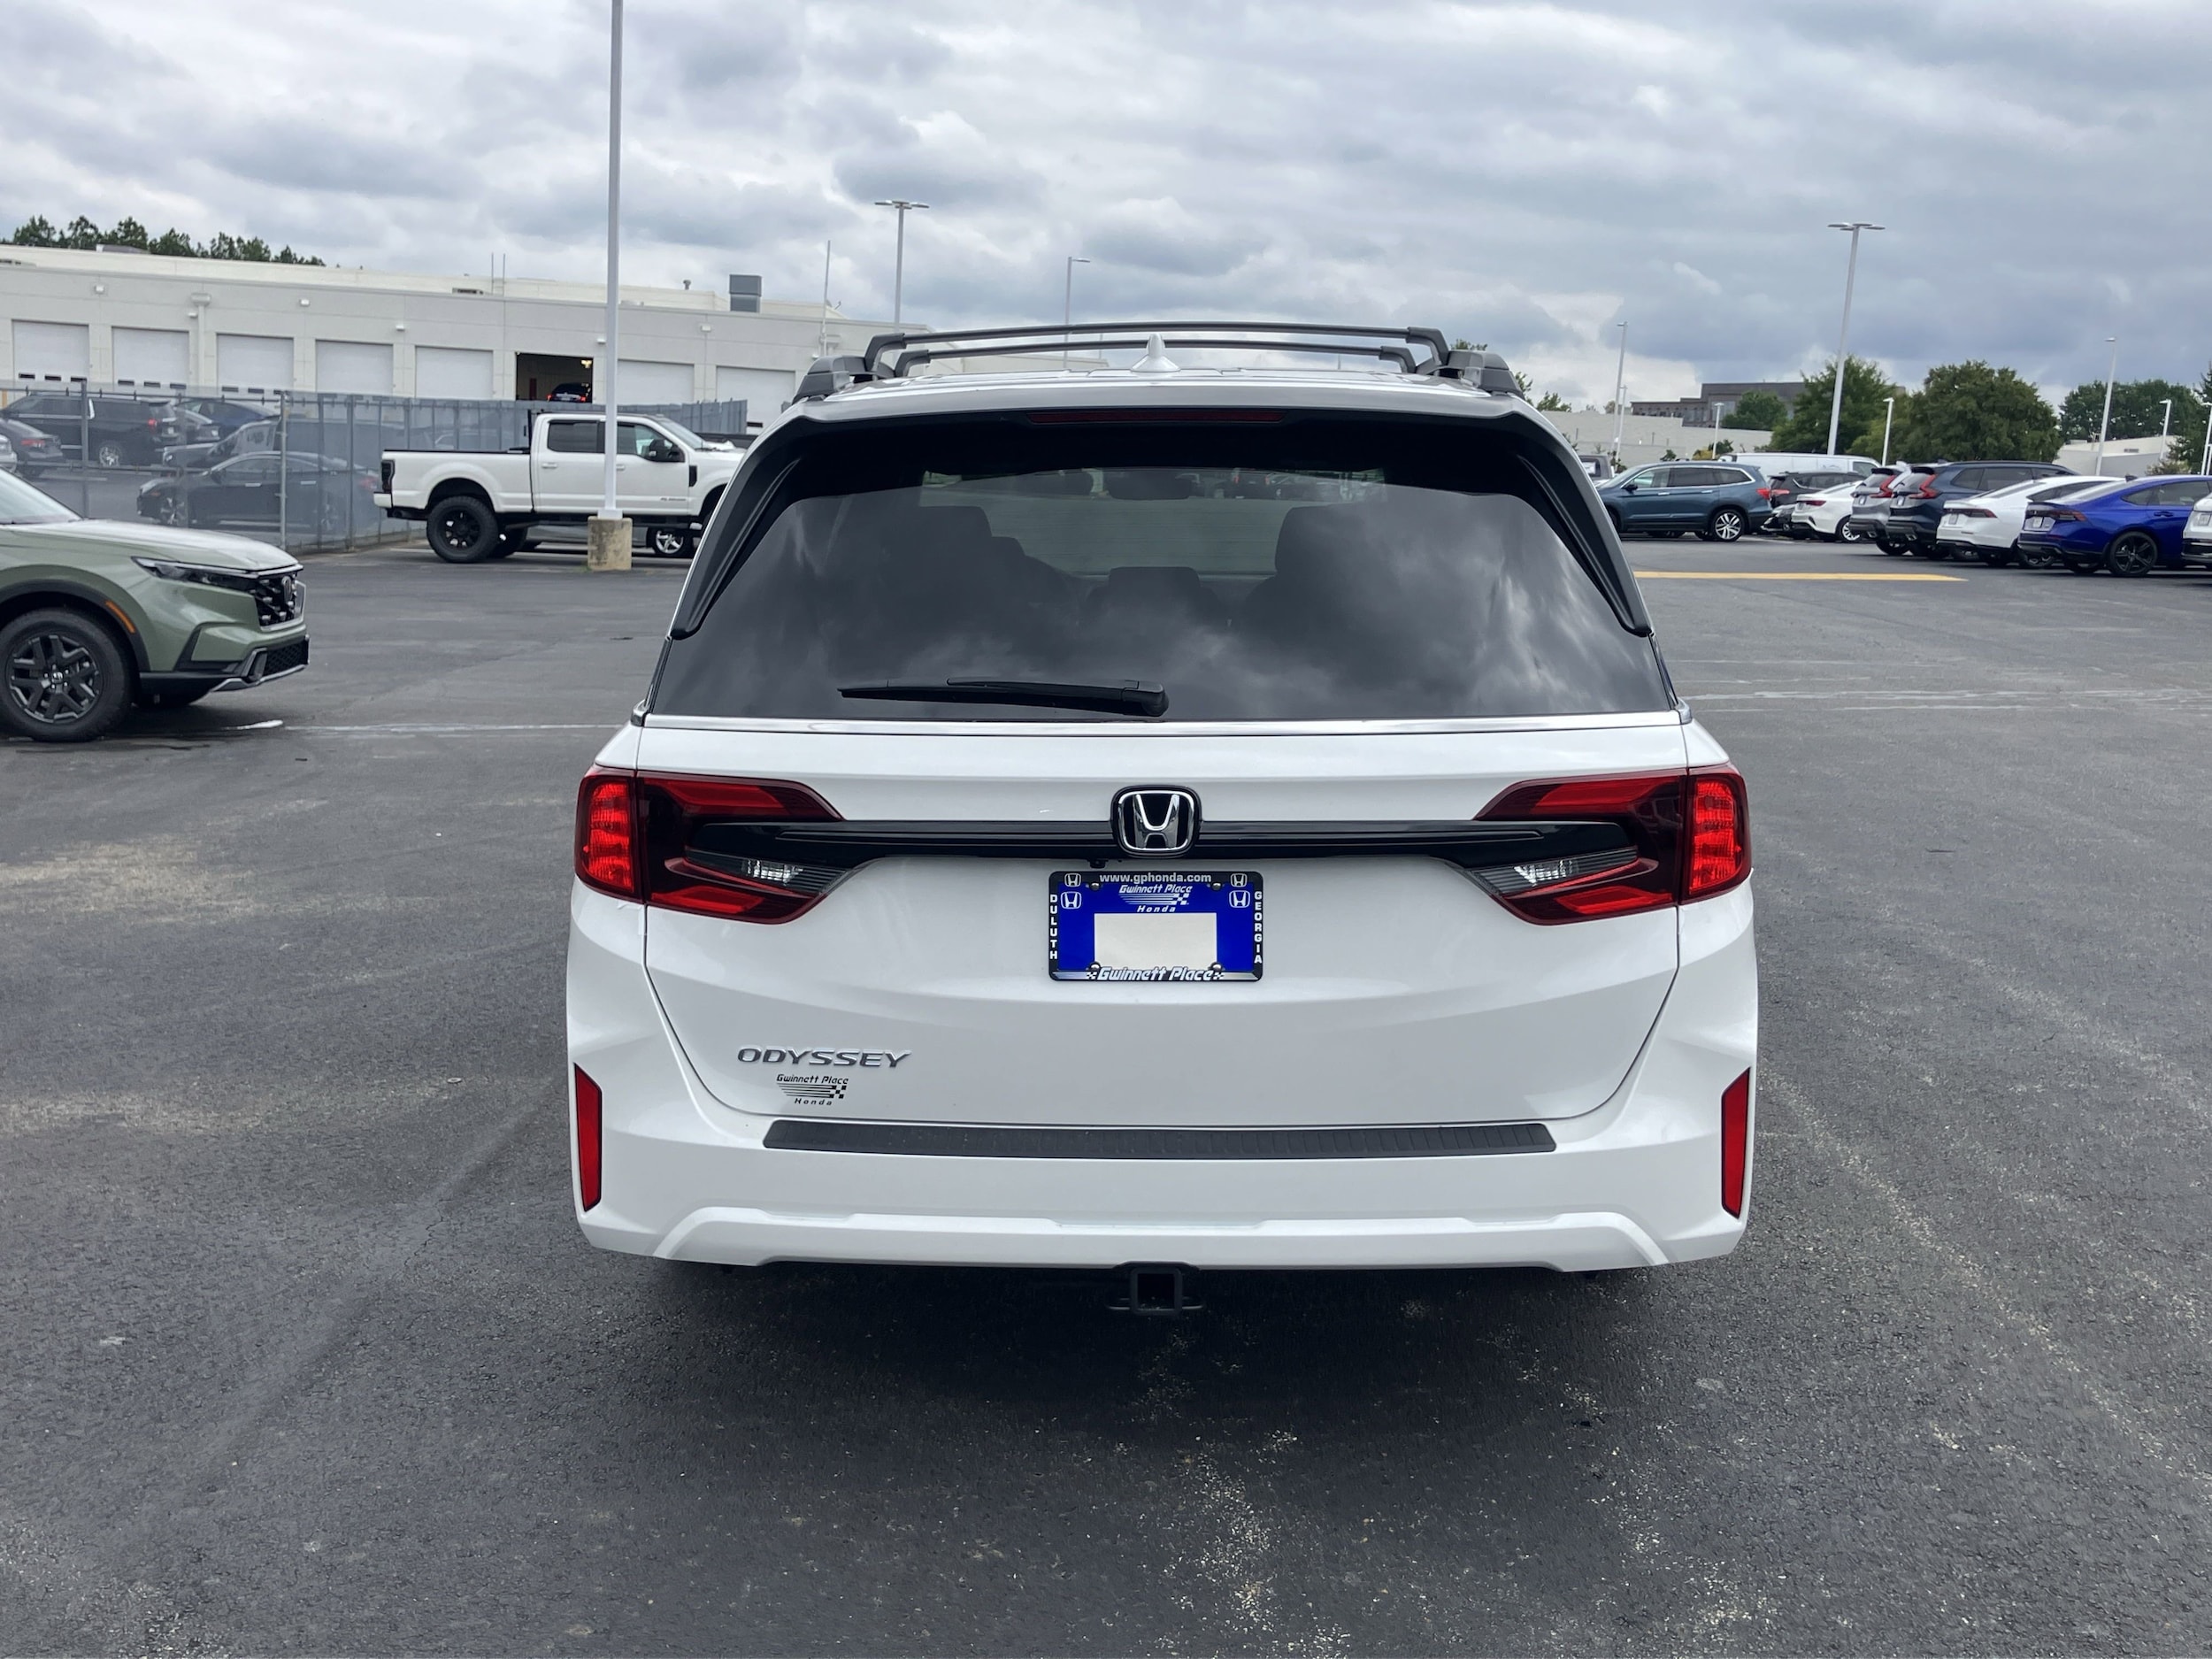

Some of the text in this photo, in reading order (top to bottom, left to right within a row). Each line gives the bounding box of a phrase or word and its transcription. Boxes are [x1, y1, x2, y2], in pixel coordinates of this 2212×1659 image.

[1099, 872, 1211, 884] www.gphonda.com
[1118, 884, 1193, 894] Gwinnett Place
[1136, 904, 1176, 913] Honda
[1049, 894, 1058, 959] DULUTH
[1254, 891, 1263, 964] GEORGIA
[1097, 966, 1215, 981] Gwinnett Place
[737, 1045, 912, 1068] ODYSSEY
[776, 1073, 849, 1086] Gwinnett Place
[794, 1097, 833, 1106] Honda
